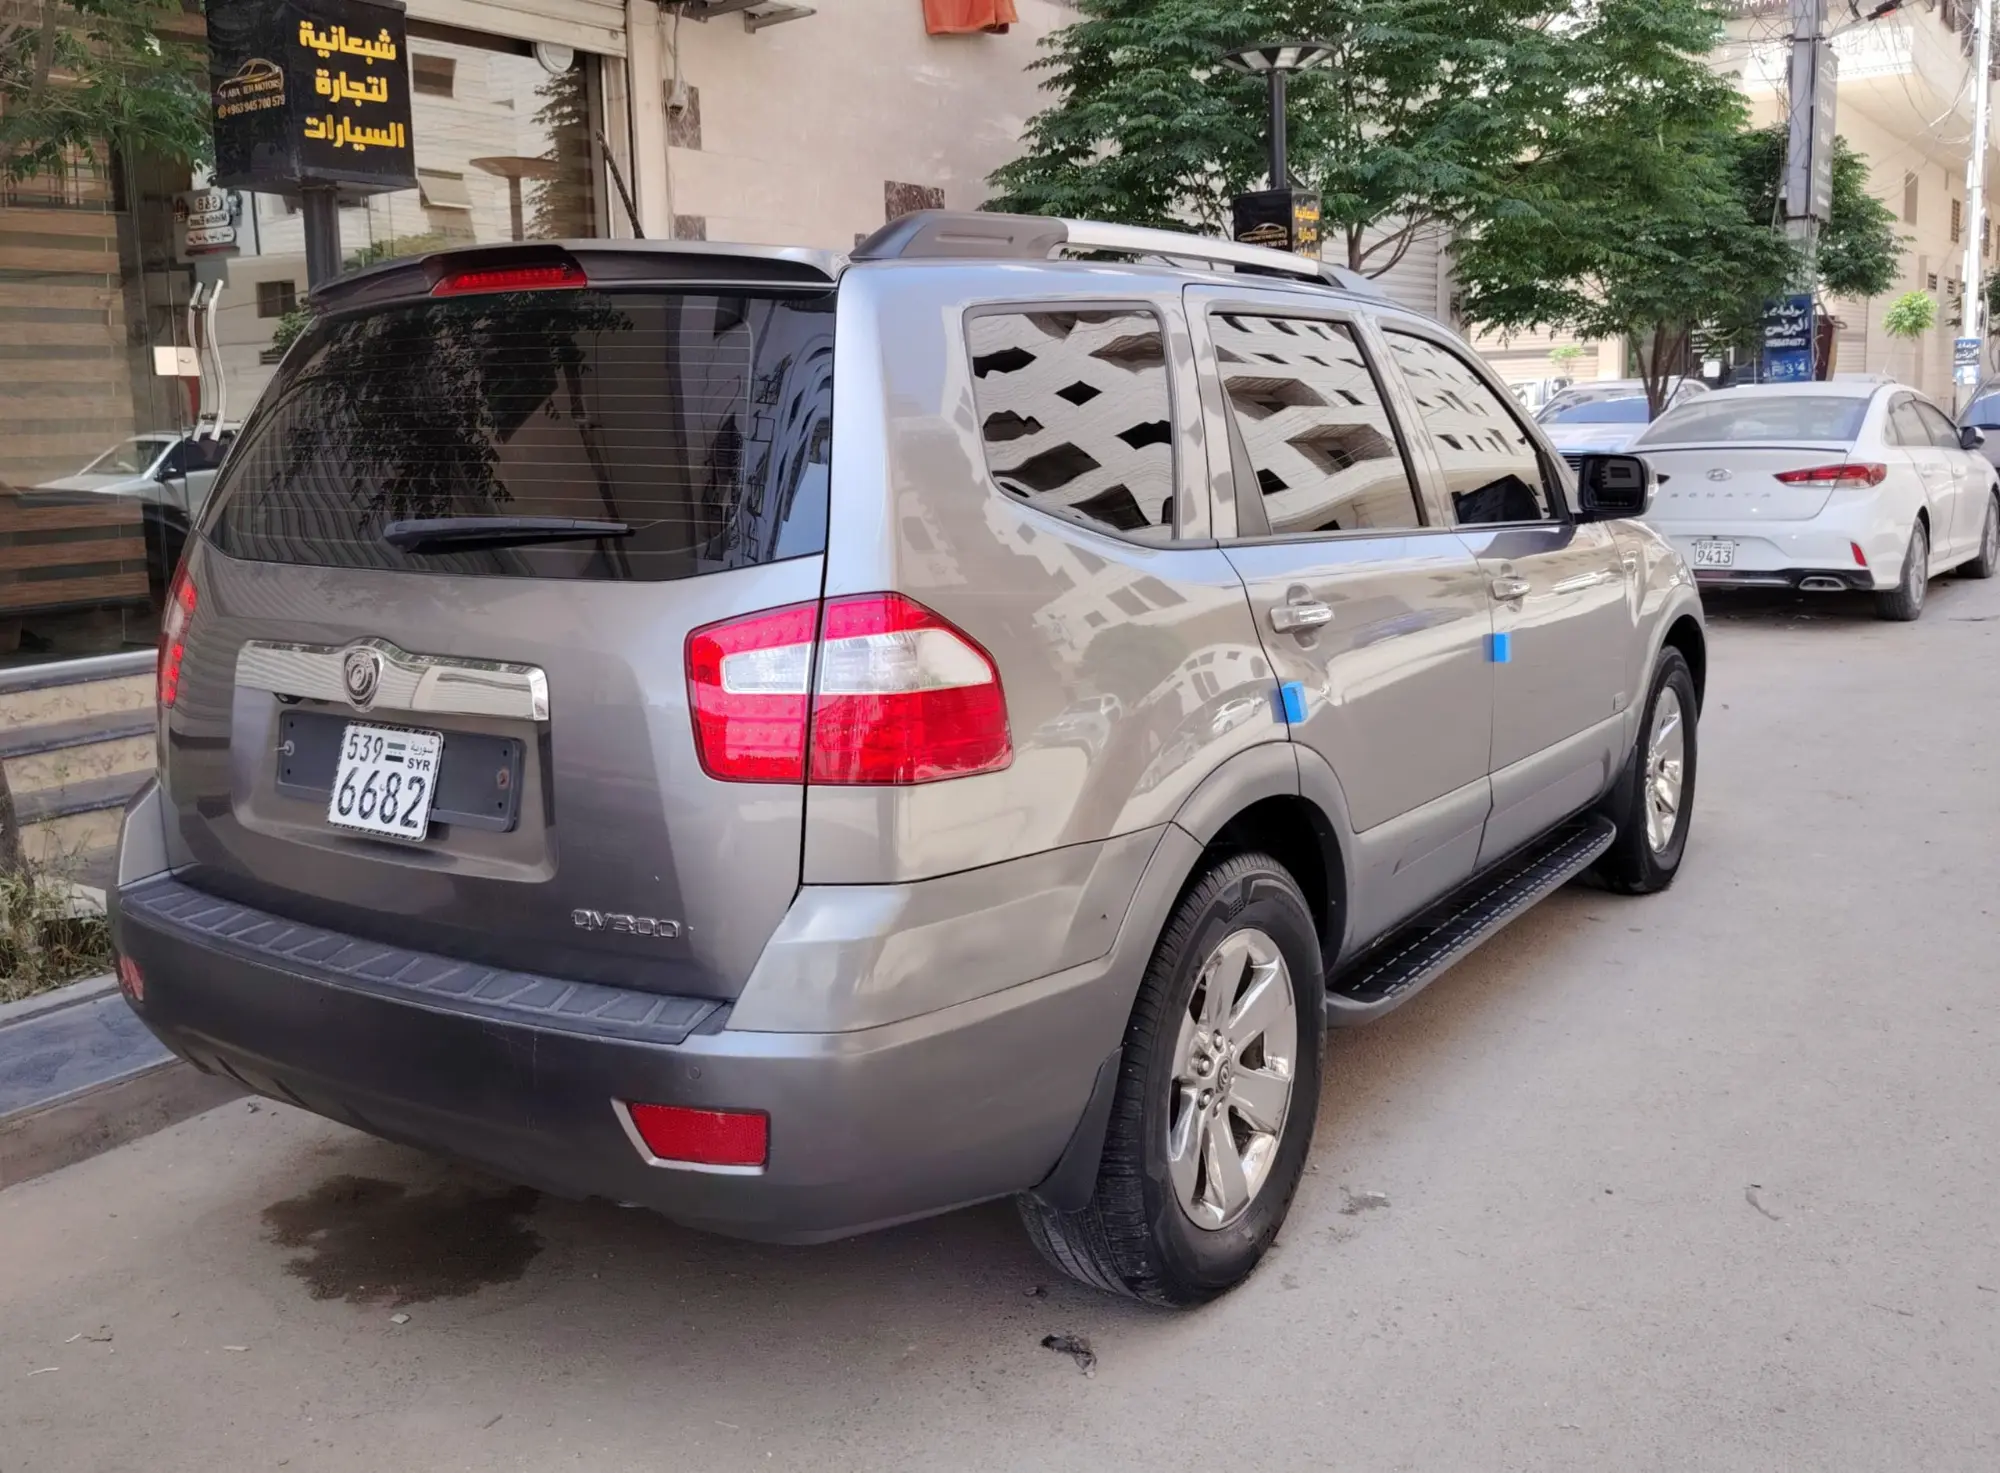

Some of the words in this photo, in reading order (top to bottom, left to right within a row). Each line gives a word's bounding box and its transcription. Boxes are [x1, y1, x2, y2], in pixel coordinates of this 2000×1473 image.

[299, 20, 397, 65] شبعانية
[315, 68, 388, 107] لتجارة
[304, 114, 405, 152] السيارات
[1697, 550, 1731, 564] 9413
[347, 733, 384, 764] 539
[407, 757, 431, 772] SYR
[337, 766, 426, 829] 6682
